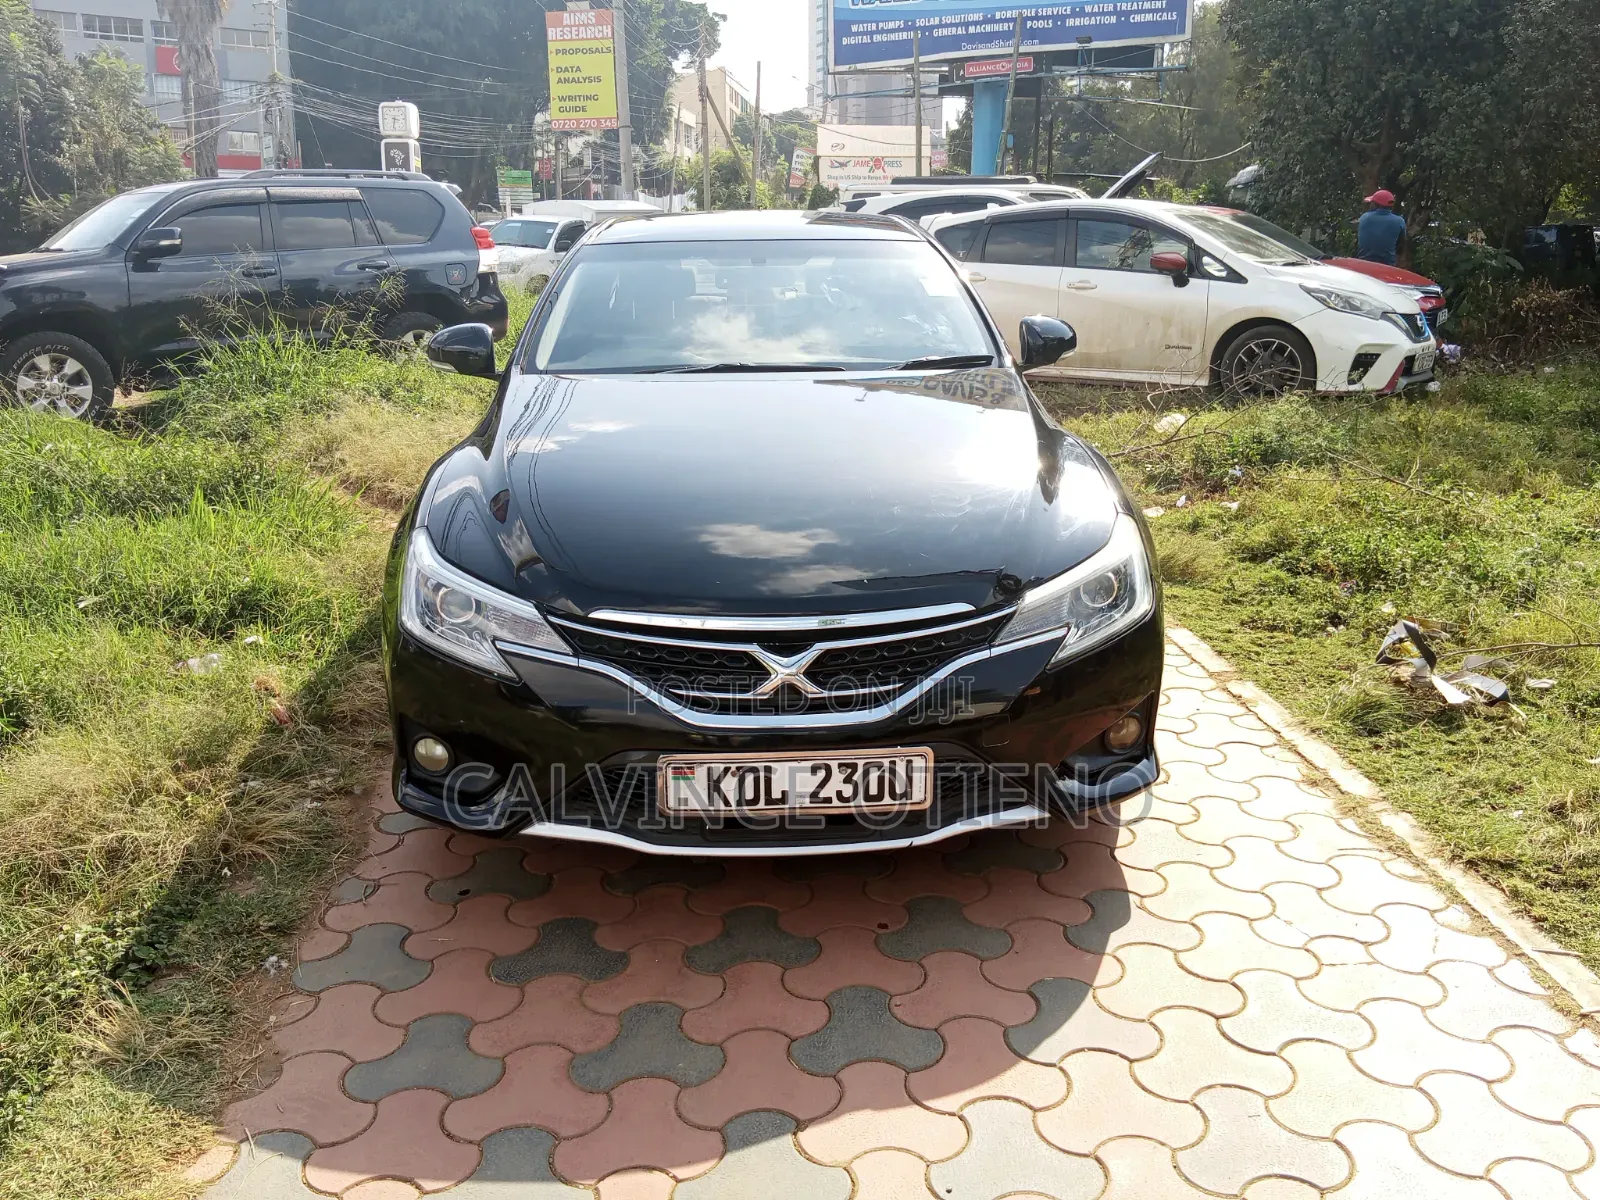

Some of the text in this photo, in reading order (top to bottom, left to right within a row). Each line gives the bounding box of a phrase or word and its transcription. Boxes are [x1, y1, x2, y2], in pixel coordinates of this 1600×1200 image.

[562, 11, 596, 25] AIMS
[850, 23, 877, 33] WATER
[878, 20, 905, 31] PUMPS
[915, 16, 940, 27] SOLAR
[941, 12, 984, 24] SOLUTIONS
[1038, 6, 1072, 16] SERVICE
[1084, 3, 1114, 13] WATER
[1117, 1, 1167, 12] TREATMENT
[548, 25, 612, 40] RESEARCH
[842, 34, 872, 45] DIGITAL
[932, 26, 967, 37] GENERAL
[968, 22, 1015, 34] MACHINERY
[1026, 19, 1053, 29] POOLS
[1066, 15, 1117, 27] IRRIGATION
[1129, 12, 1177, 23] CHEMICALS
[555, 46, 612, 56] PROPOSALS
[555, 65, 582, 74] DATA
[968, 63, 1000, 73] ALLIANCE
[556, 76, 602, 84] ANALYSIS
[557, 94, 599, 102] WRITING
[558, 105, 588, 113] GUIDE
[551, 119, 617, 129] 0720 270 345
[808, 759, 914, 805] 230U
